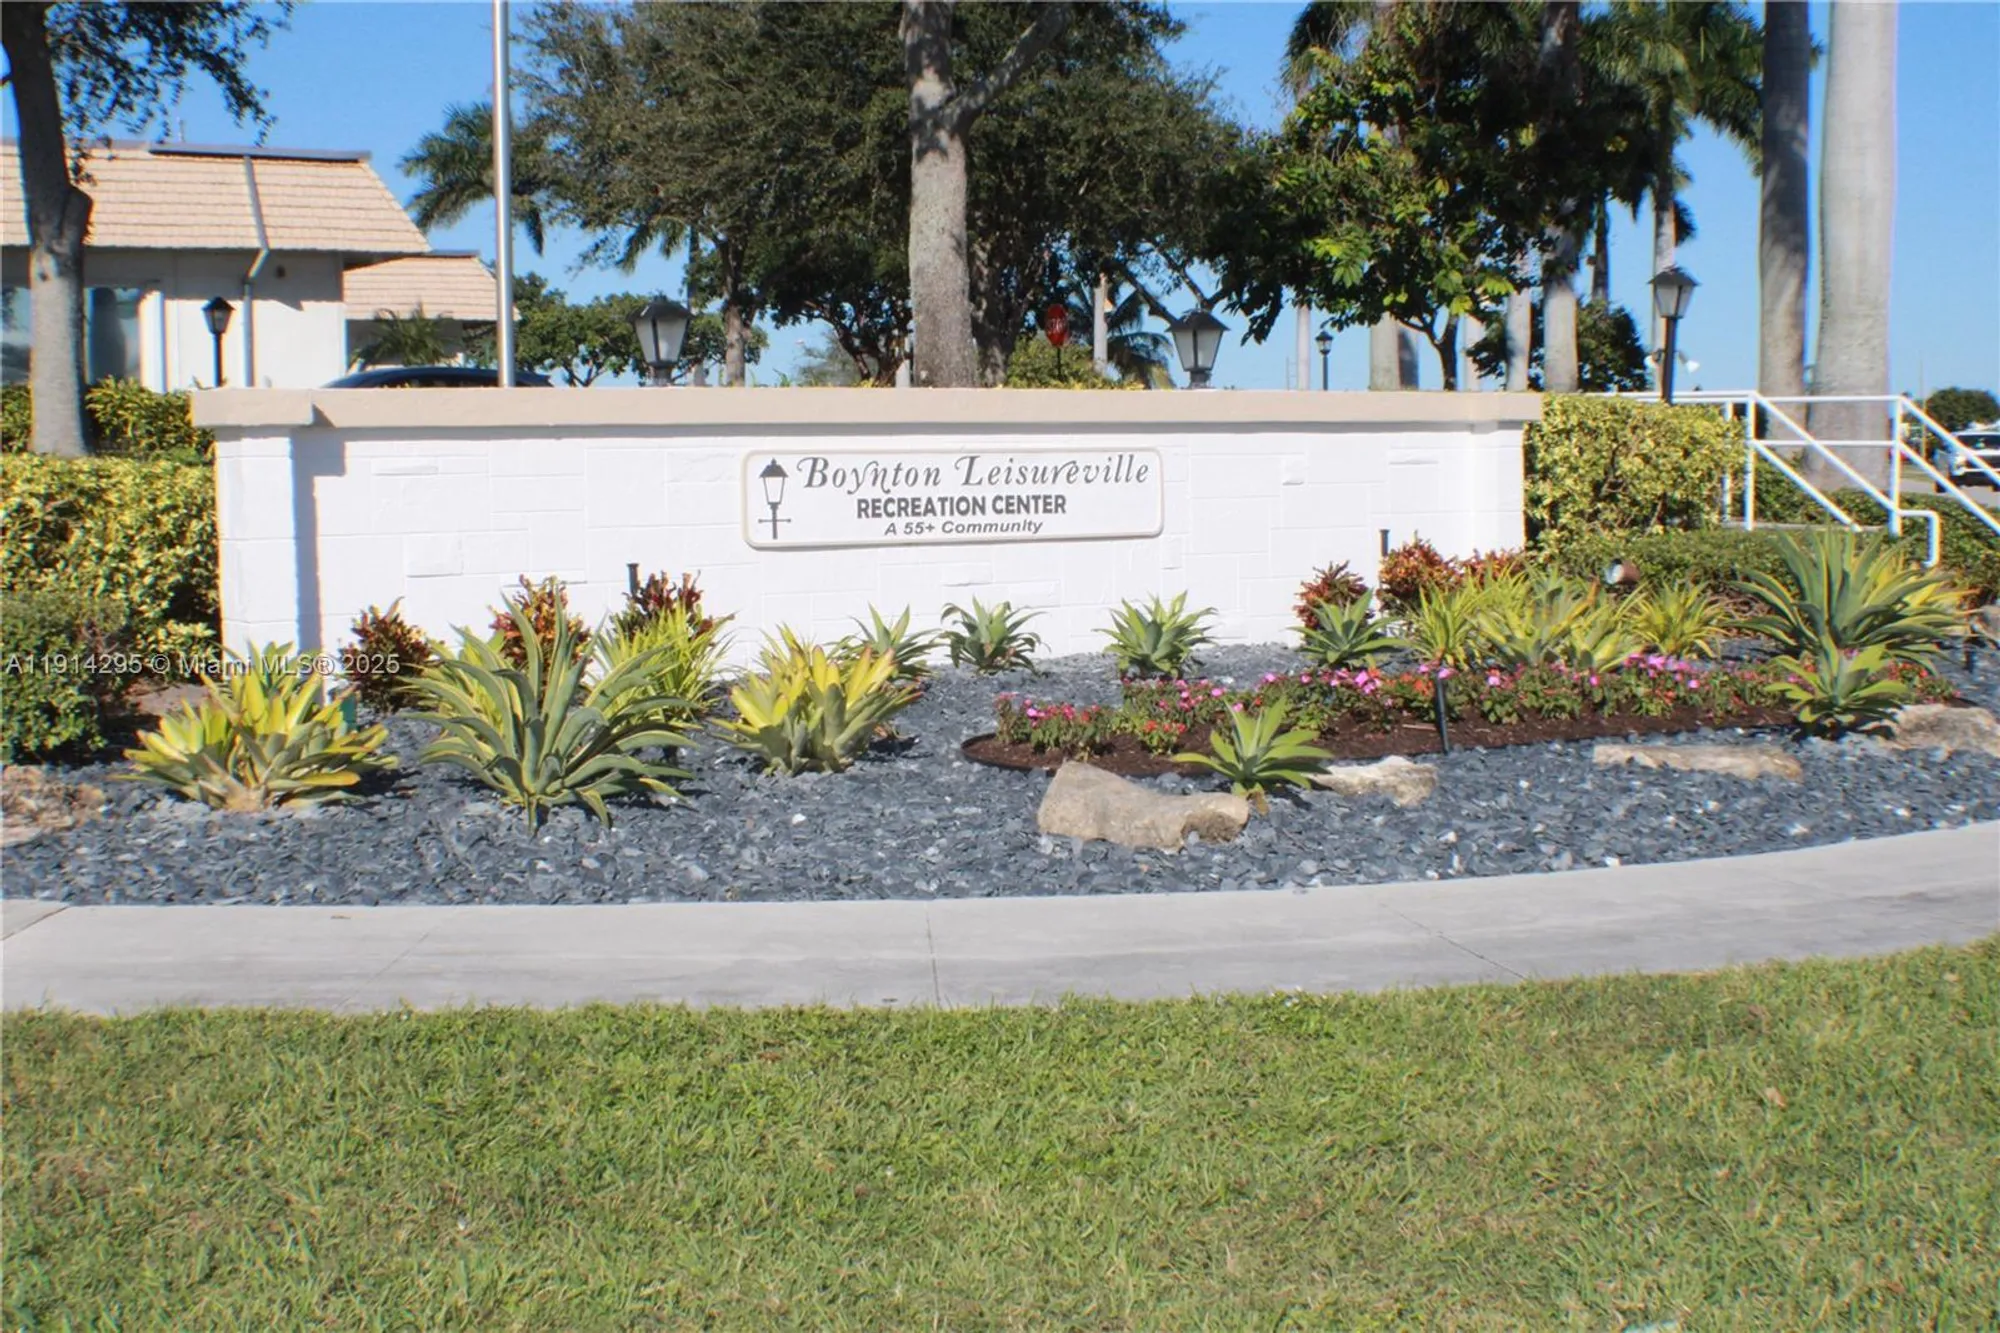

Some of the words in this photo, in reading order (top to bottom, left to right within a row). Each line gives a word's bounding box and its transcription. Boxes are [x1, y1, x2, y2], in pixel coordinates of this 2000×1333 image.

[796, 456, 941, 494] Boynton
[954, 454, 1149, 486] Leisureville
[857, 496, 983, 518] RECREATION
[991, 494, 1067, 515] CENTER
[884, 521, 897, 536] A
[903, 521, 935, 535] 55+
[941, 519, 1043, 534] Community
